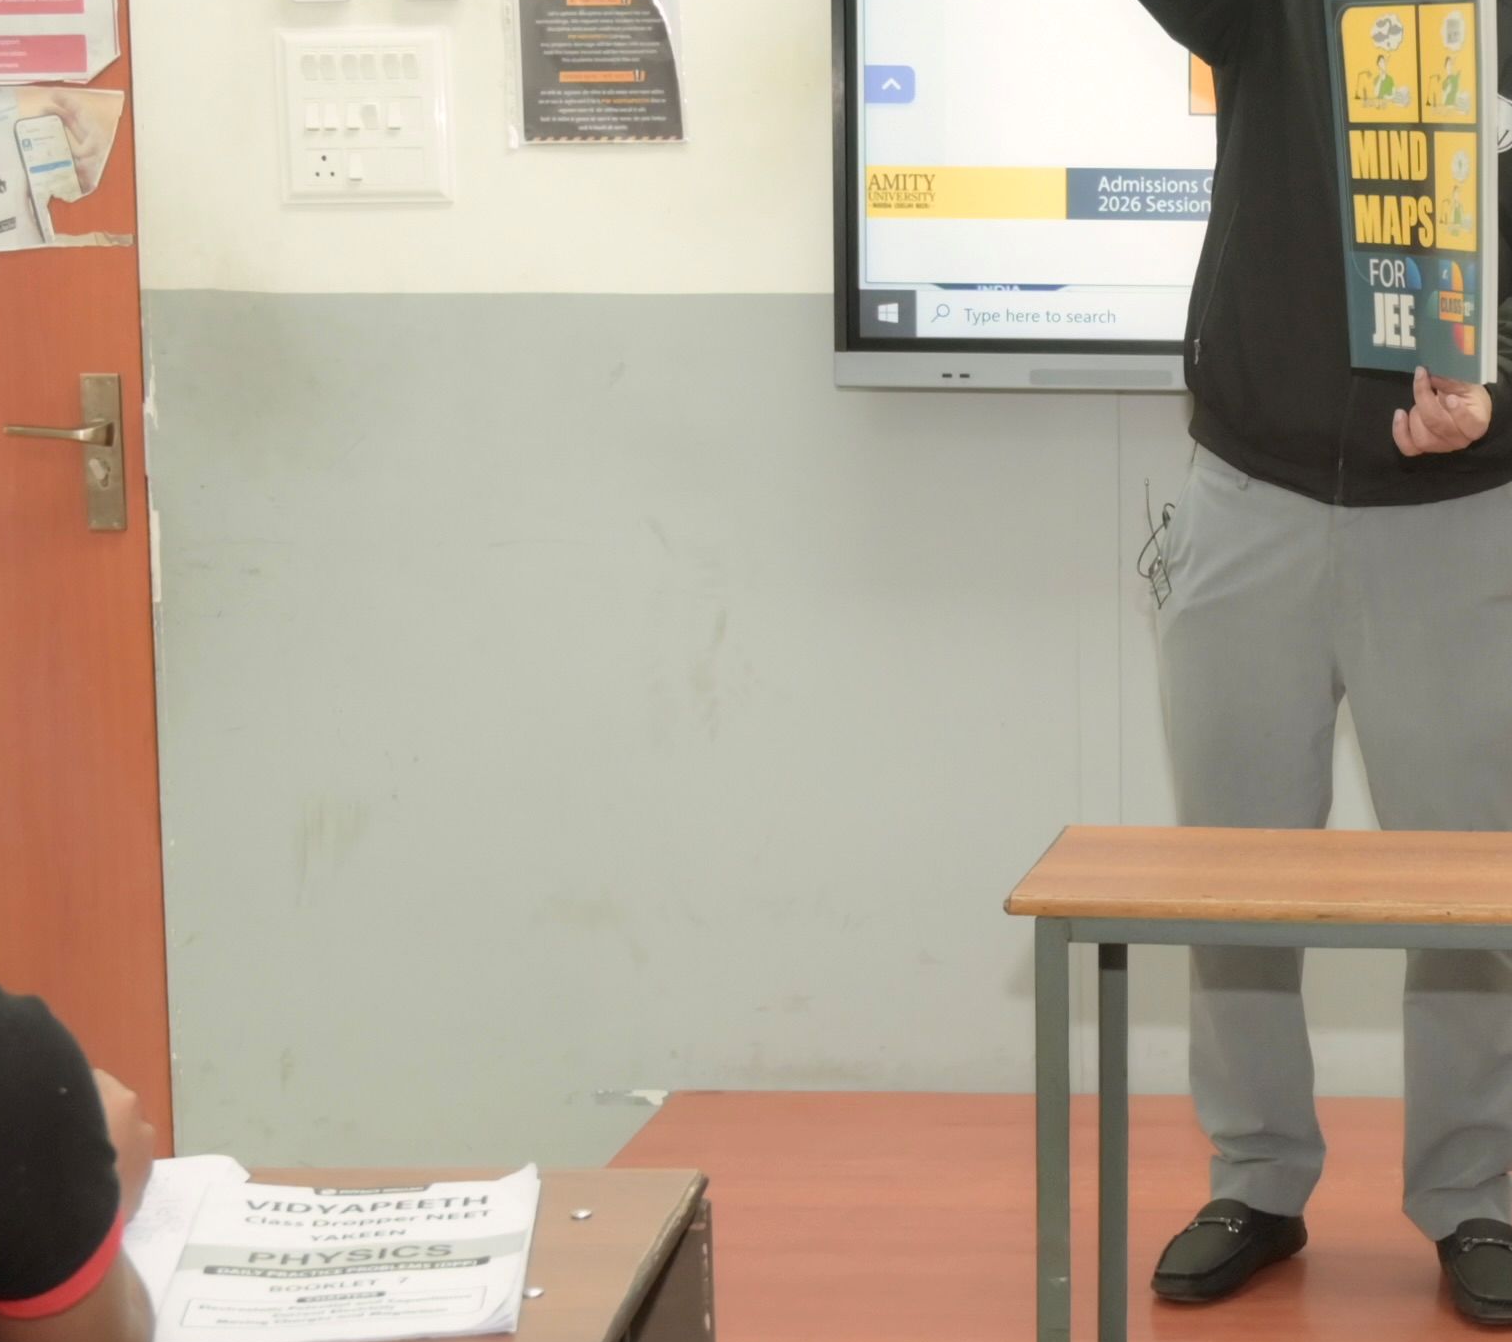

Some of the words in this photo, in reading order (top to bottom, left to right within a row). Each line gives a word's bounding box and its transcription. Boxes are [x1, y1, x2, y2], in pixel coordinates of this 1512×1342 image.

[1348, 129, 1428, 181] MIND
[867, 173, 936, 192] AMITY
[1097, 175, 1198, 194] Admissions
[867, 191, 936, 203] UNIVERSITY
[1097, 195, 1142, 213] 2026
[1145, 196, 1212, 213] Session
[1352, 194, 1434, 248] MAPS
[1369, 258, 1406, 289] FOR
[963, 307, 1001, 326] Type
[1005, 308, 1040, 323] here
[1045, 310, 1062, 323] to
[1065, 308, 1117, 324] search
[1373, 291, 1417, 351] JEE
[245, 1194, 490, 1216] VIDYAPEETH
[244, 1215, 305, 1228] Class
[311, 1213, 418, 1229] Dropper
[425, 1209, 493, 1222] NEET
[247, 1243, 454, 1266] PHYSICS
